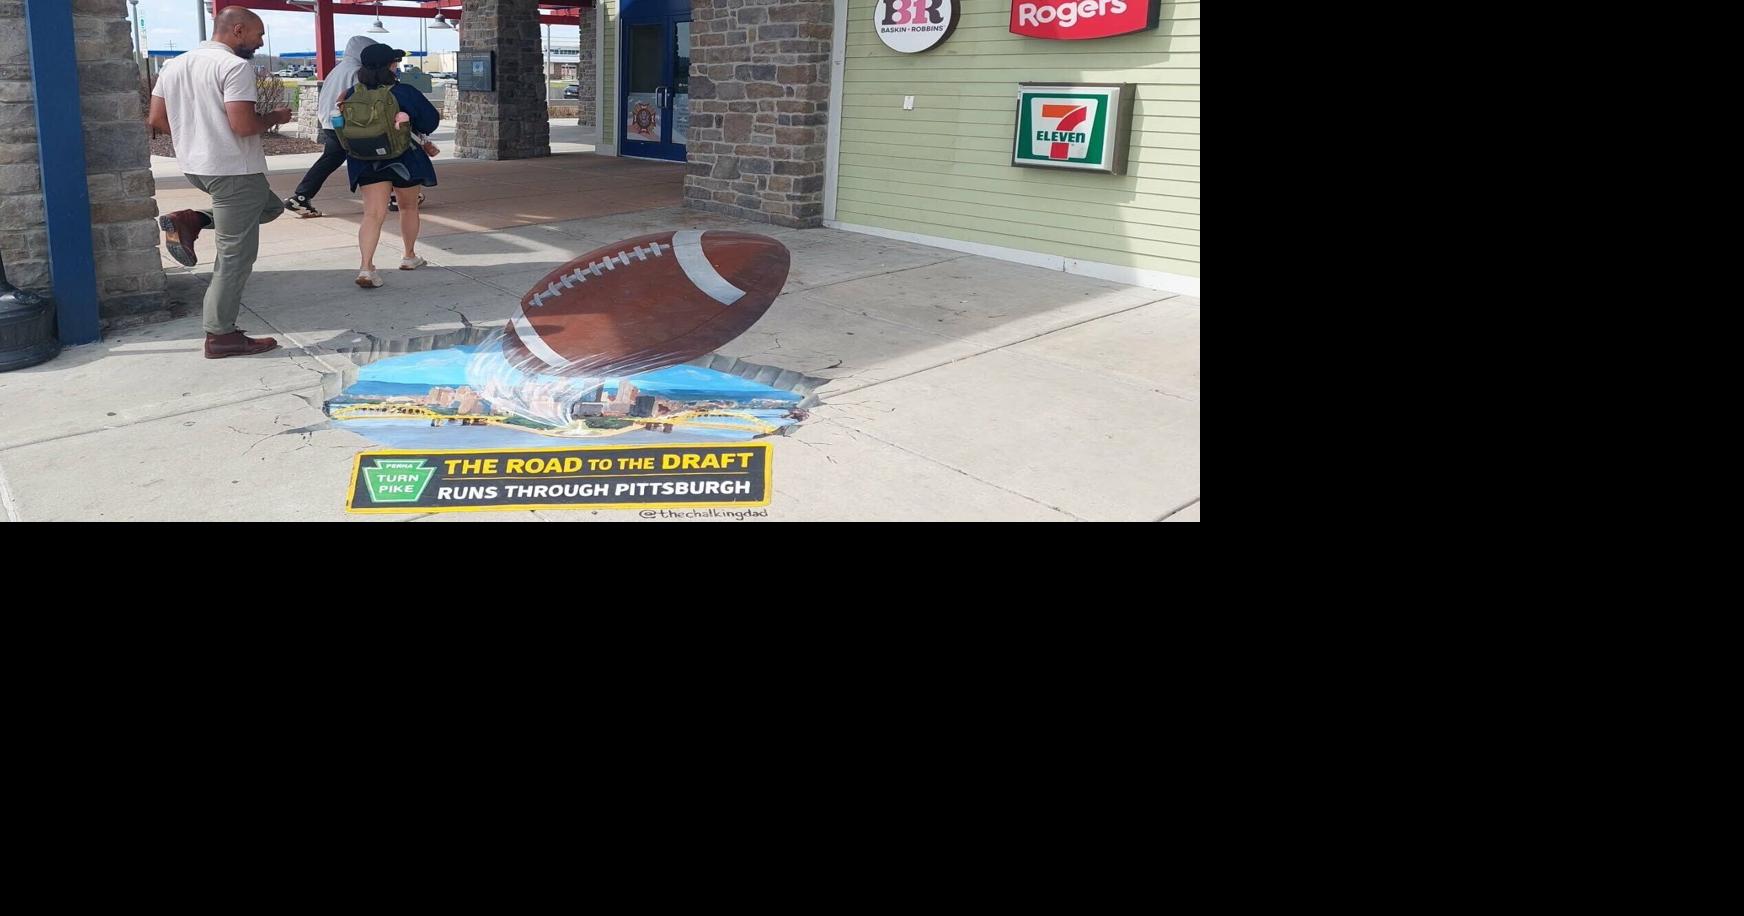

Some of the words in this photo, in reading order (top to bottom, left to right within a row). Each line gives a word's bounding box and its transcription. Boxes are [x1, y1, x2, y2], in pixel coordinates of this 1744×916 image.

[1019, 0, 1127, 27] Rogers
[1041, 104, 1087, 159] 7
[444, 459, 499, 475] THE
[506, 457, 583, 474] ROAD
[588, 459, 613, 471] TO
[617, 457, 656, 470] THE
[662, 453, 754, 470] DRAFT
[377, 474, 419, 483] TURN
[378, 485, 415, 493] PIKE
[437, 487, 498, 500] RUNS
[504, 483, 609, 498] THROUGH
[615, 480, 751, 496] PITTSBURGH
[639, 509, 768, 521] @thechalkingdad
